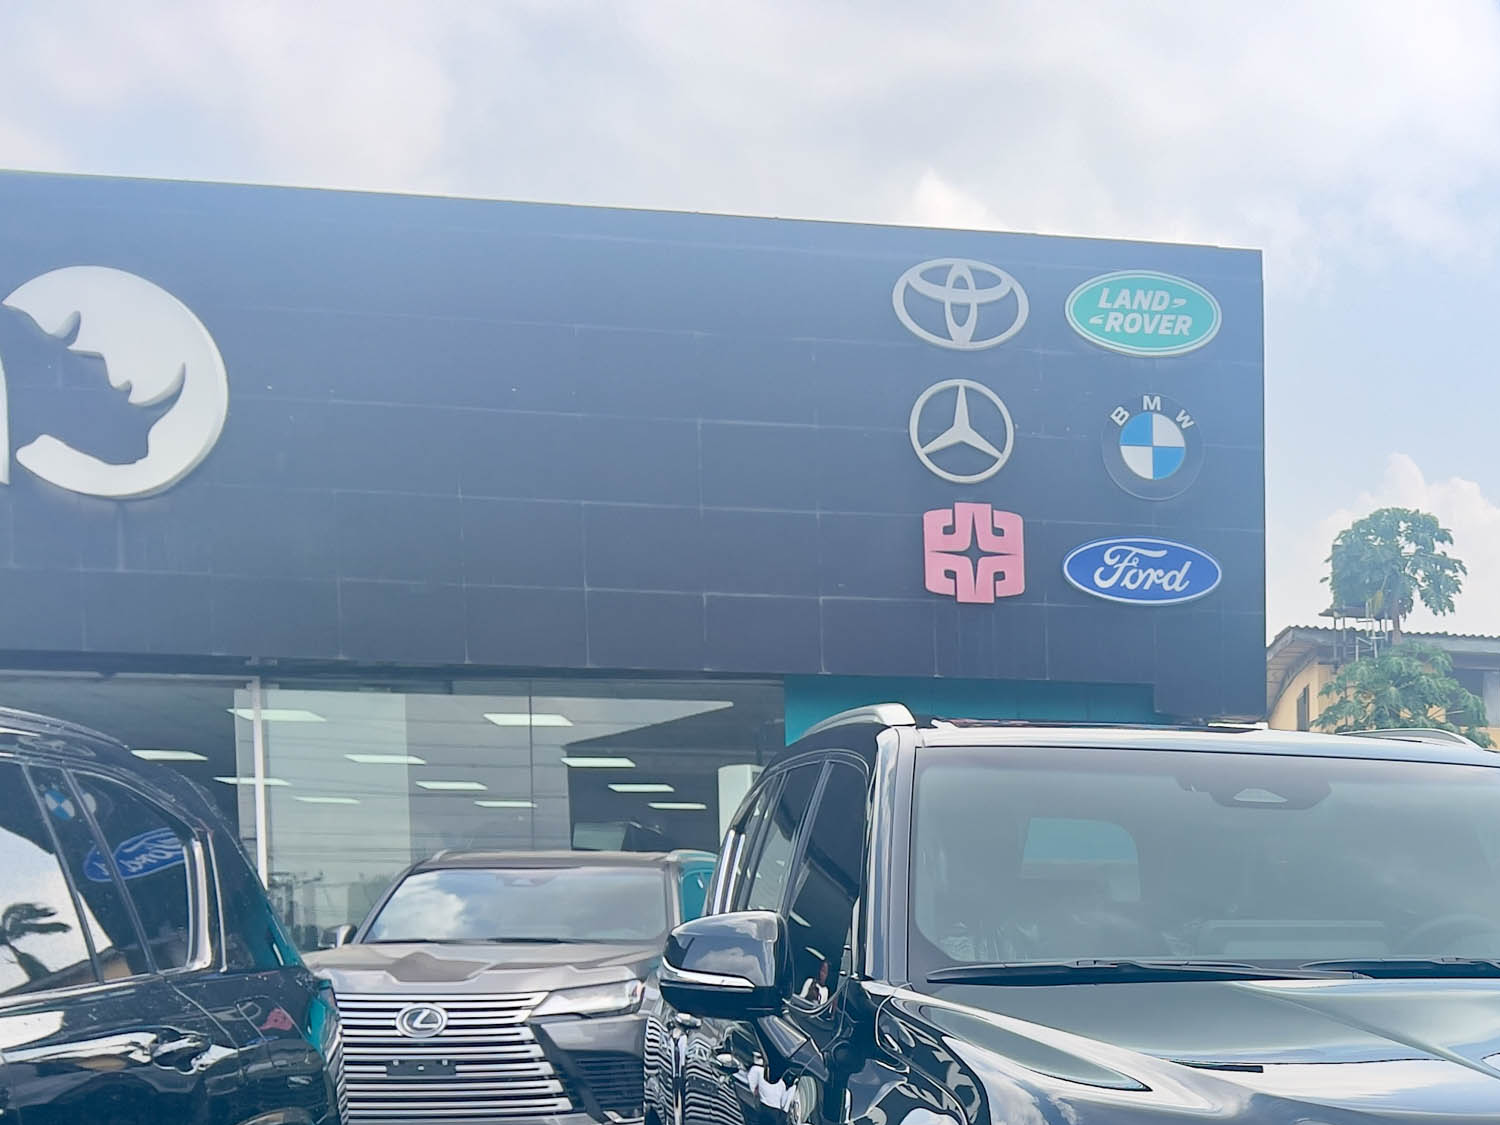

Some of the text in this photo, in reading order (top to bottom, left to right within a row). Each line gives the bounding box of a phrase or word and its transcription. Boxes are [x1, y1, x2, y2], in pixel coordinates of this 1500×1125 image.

[1098, 287, 1170, 311] LAND
[1104, 312, 1193, 336] ROVER
[1110, 395, 1194, 430] BMW
[1093, 545, 1192, 592] Ford
